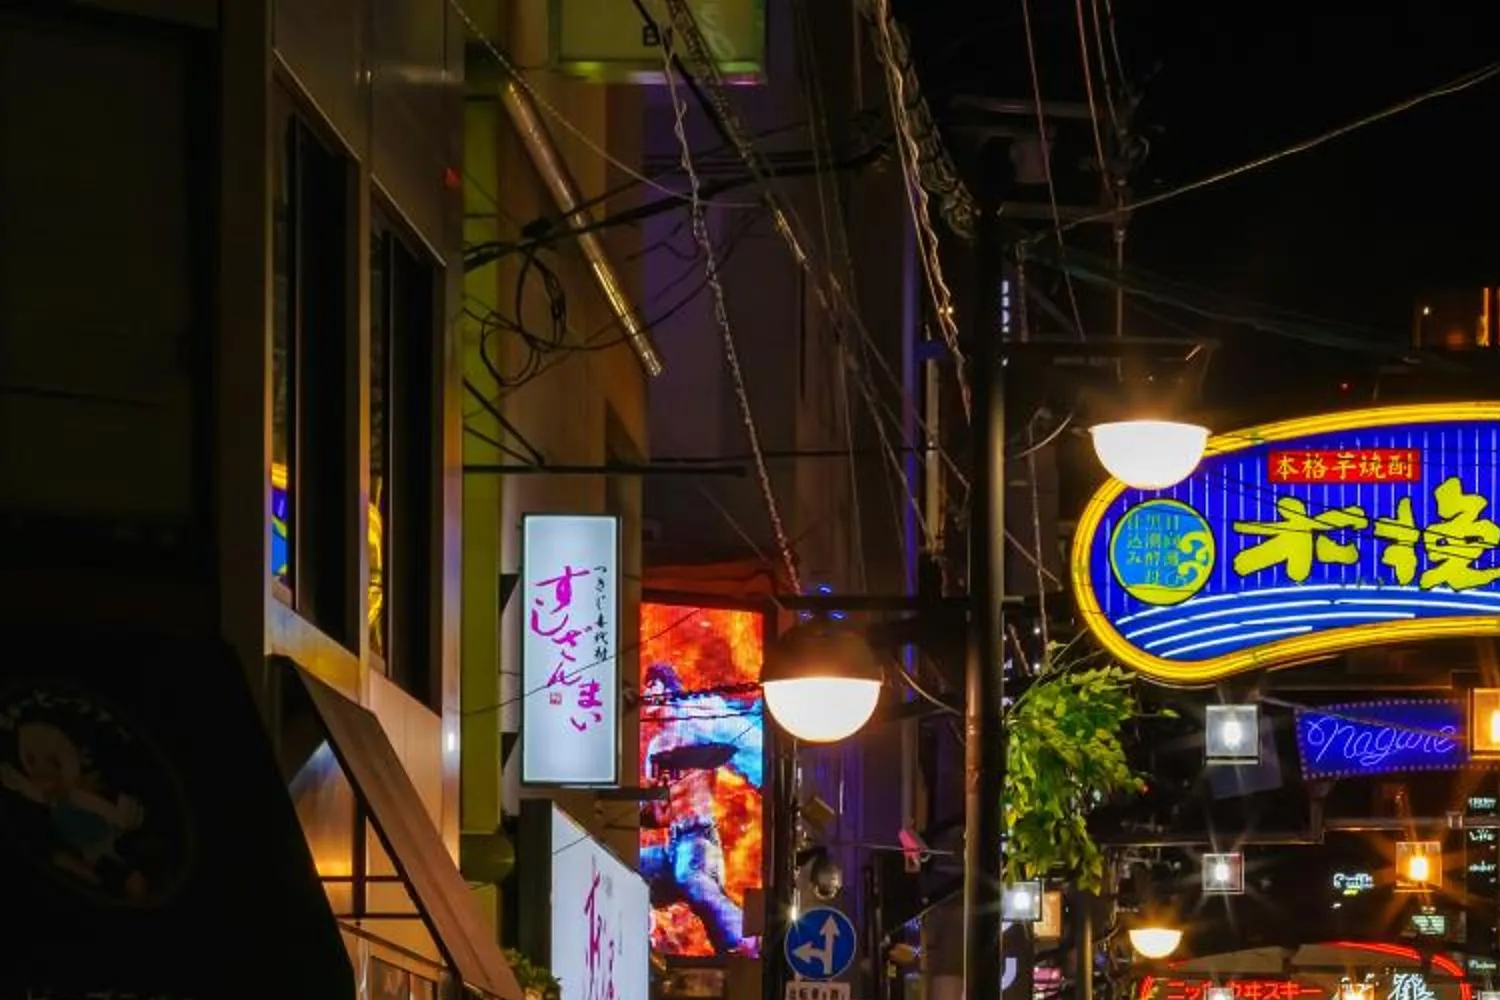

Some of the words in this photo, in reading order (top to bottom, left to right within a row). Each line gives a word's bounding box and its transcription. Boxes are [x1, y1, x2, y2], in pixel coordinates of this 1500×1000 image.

[1275, 452, 1413, 481] 本格芋焼酎
[531, 565, 603, 732] すしざんまい
[1167, 980, 1322, 1000] ニッウヰスキー
